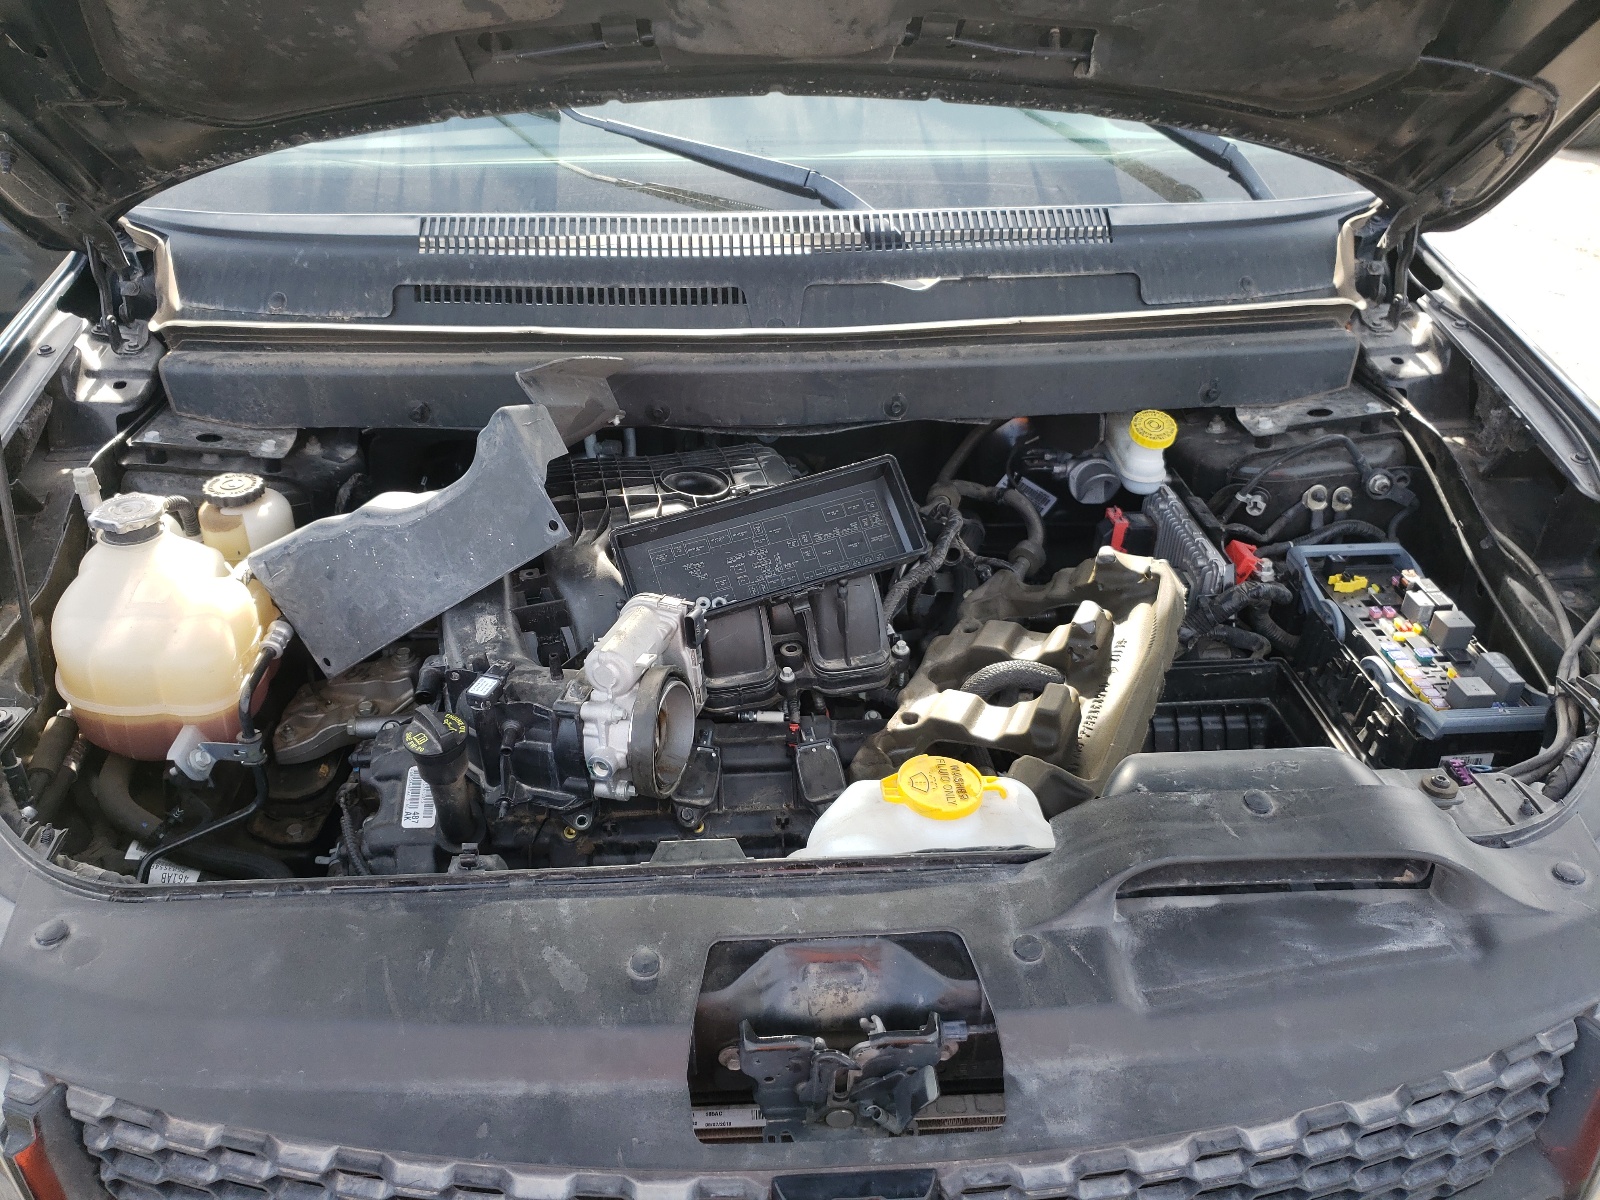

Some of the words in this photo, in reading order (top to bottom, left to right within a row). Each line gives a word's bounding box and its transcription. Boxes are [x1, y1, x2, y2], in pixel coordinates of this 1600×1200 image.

[445, 713, 465, 727] ENGINE
[936, 758, 950, 783] FLUID
[943, 784, 957, 806] ONLY
[950, 764, 968, 801] WASHER
[403, 811, 412, 822] AK
[161, 872, 189, 884] 461AB
